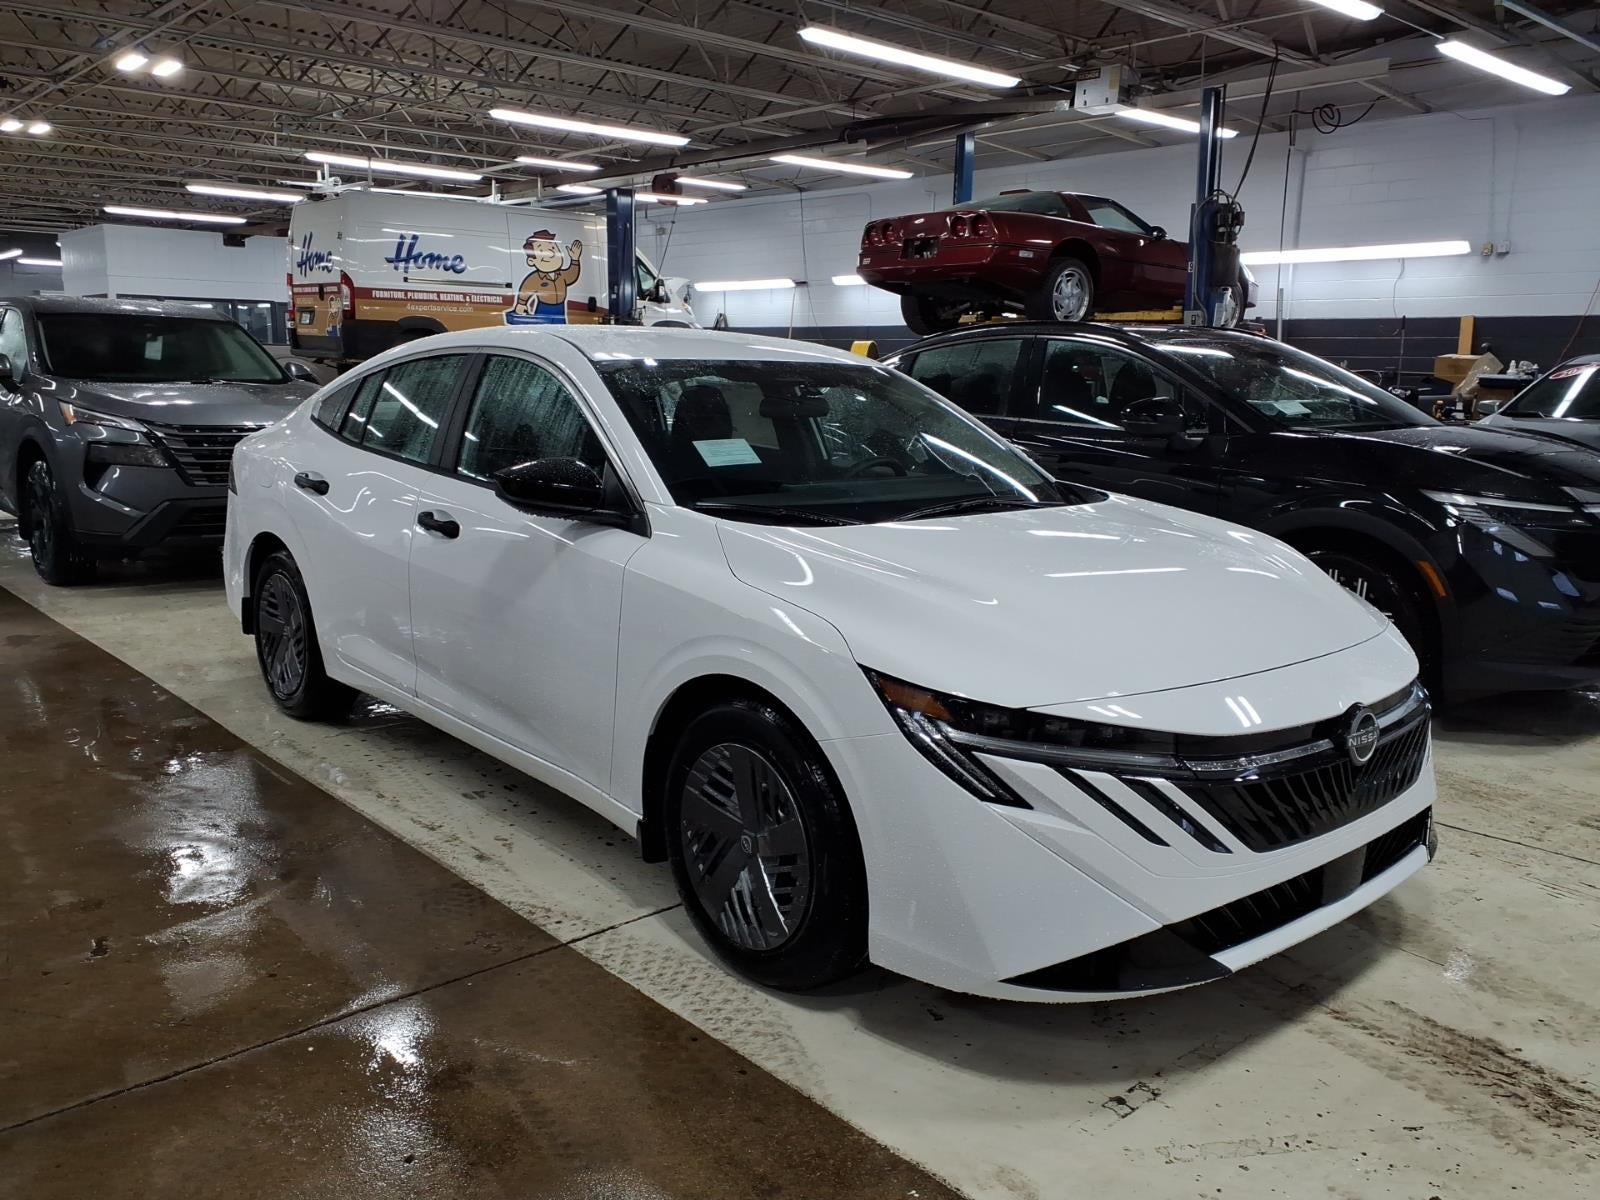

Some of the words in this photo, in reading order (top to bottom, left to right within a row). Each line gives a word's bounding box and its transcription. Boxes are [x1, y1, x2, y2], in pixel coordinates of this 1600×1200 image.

[296, 231, 334, 277] Home
[384, 233, 467, 275] Home
[372, 290, 406, 299] FURNITURE,
[407, 291, 439, 301] PLUMBING,
[439, 293, 465, 303] HEATING,
[471, 295, 503, 304] ELECTRICAL
